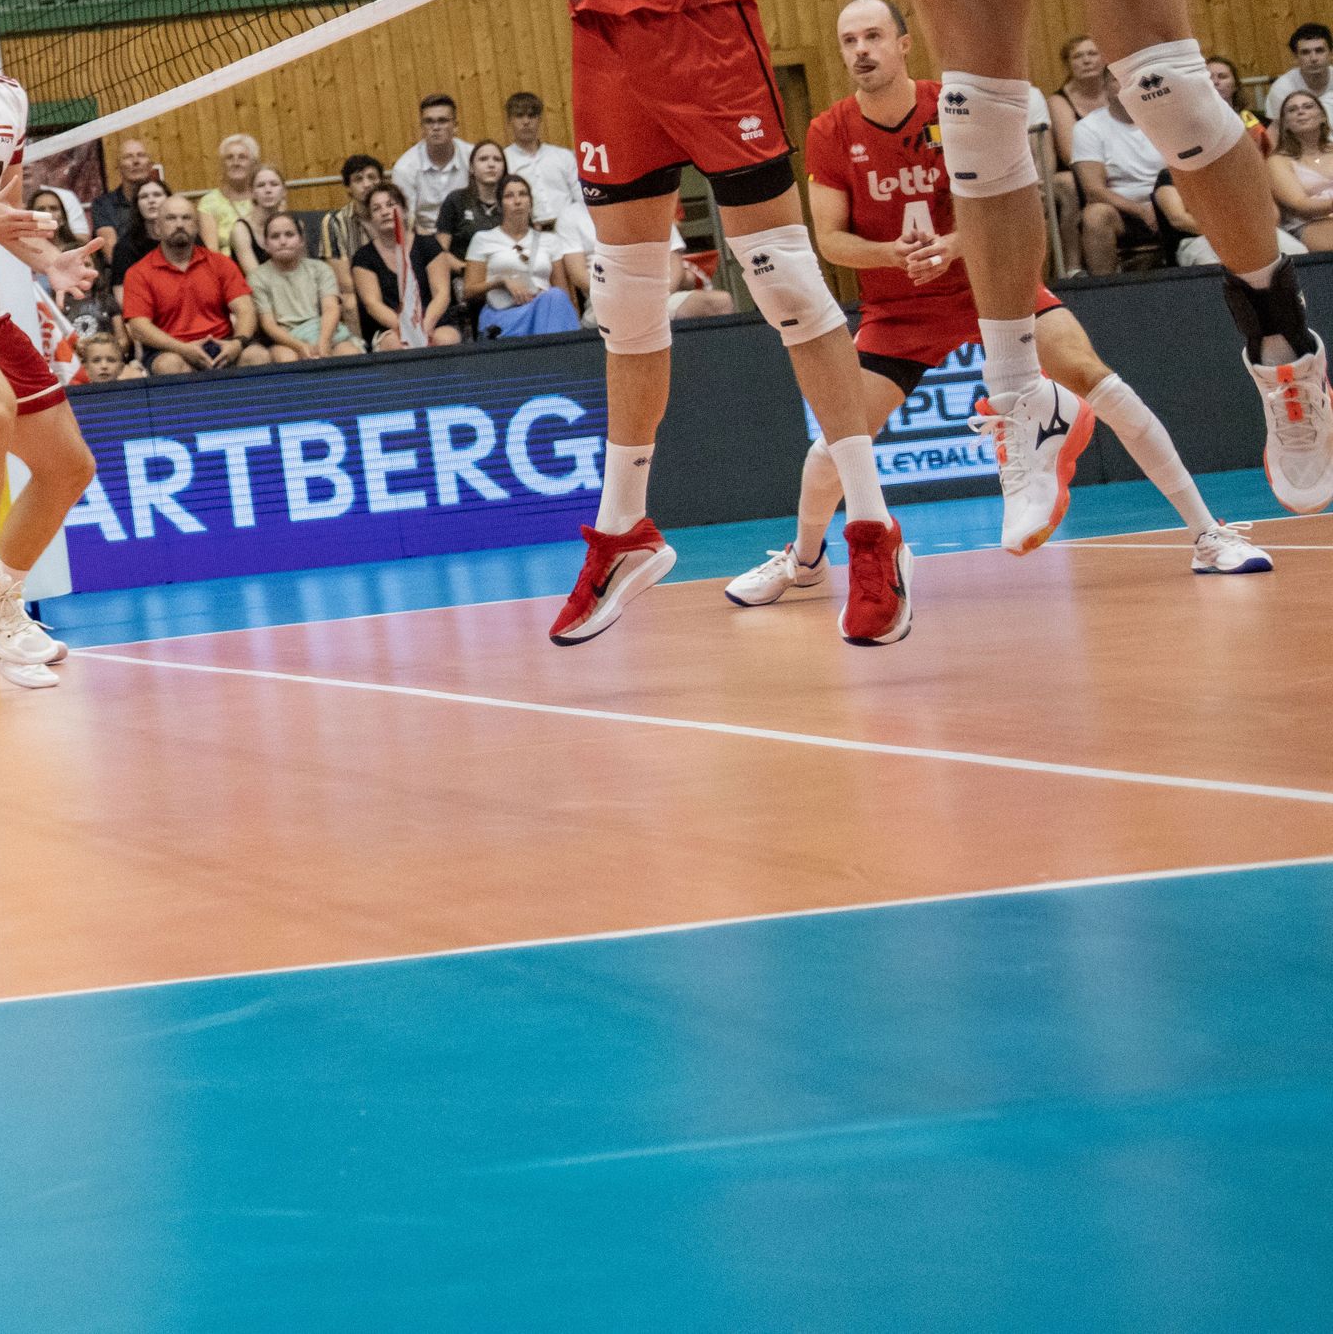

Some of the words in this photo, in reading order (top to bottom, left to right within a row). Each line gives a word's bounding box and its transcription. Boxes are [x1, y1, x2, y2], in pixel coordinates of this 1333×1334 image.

[740, 127, 765, 141] errea
[580, 140, 611, 174] 21
[901, 200, 935, 236] 4
[899, 382, 991, 427] PLA
[61, 394, 606, 546] ARTBERG
[876, 443, 997, 475] LEYBALL
